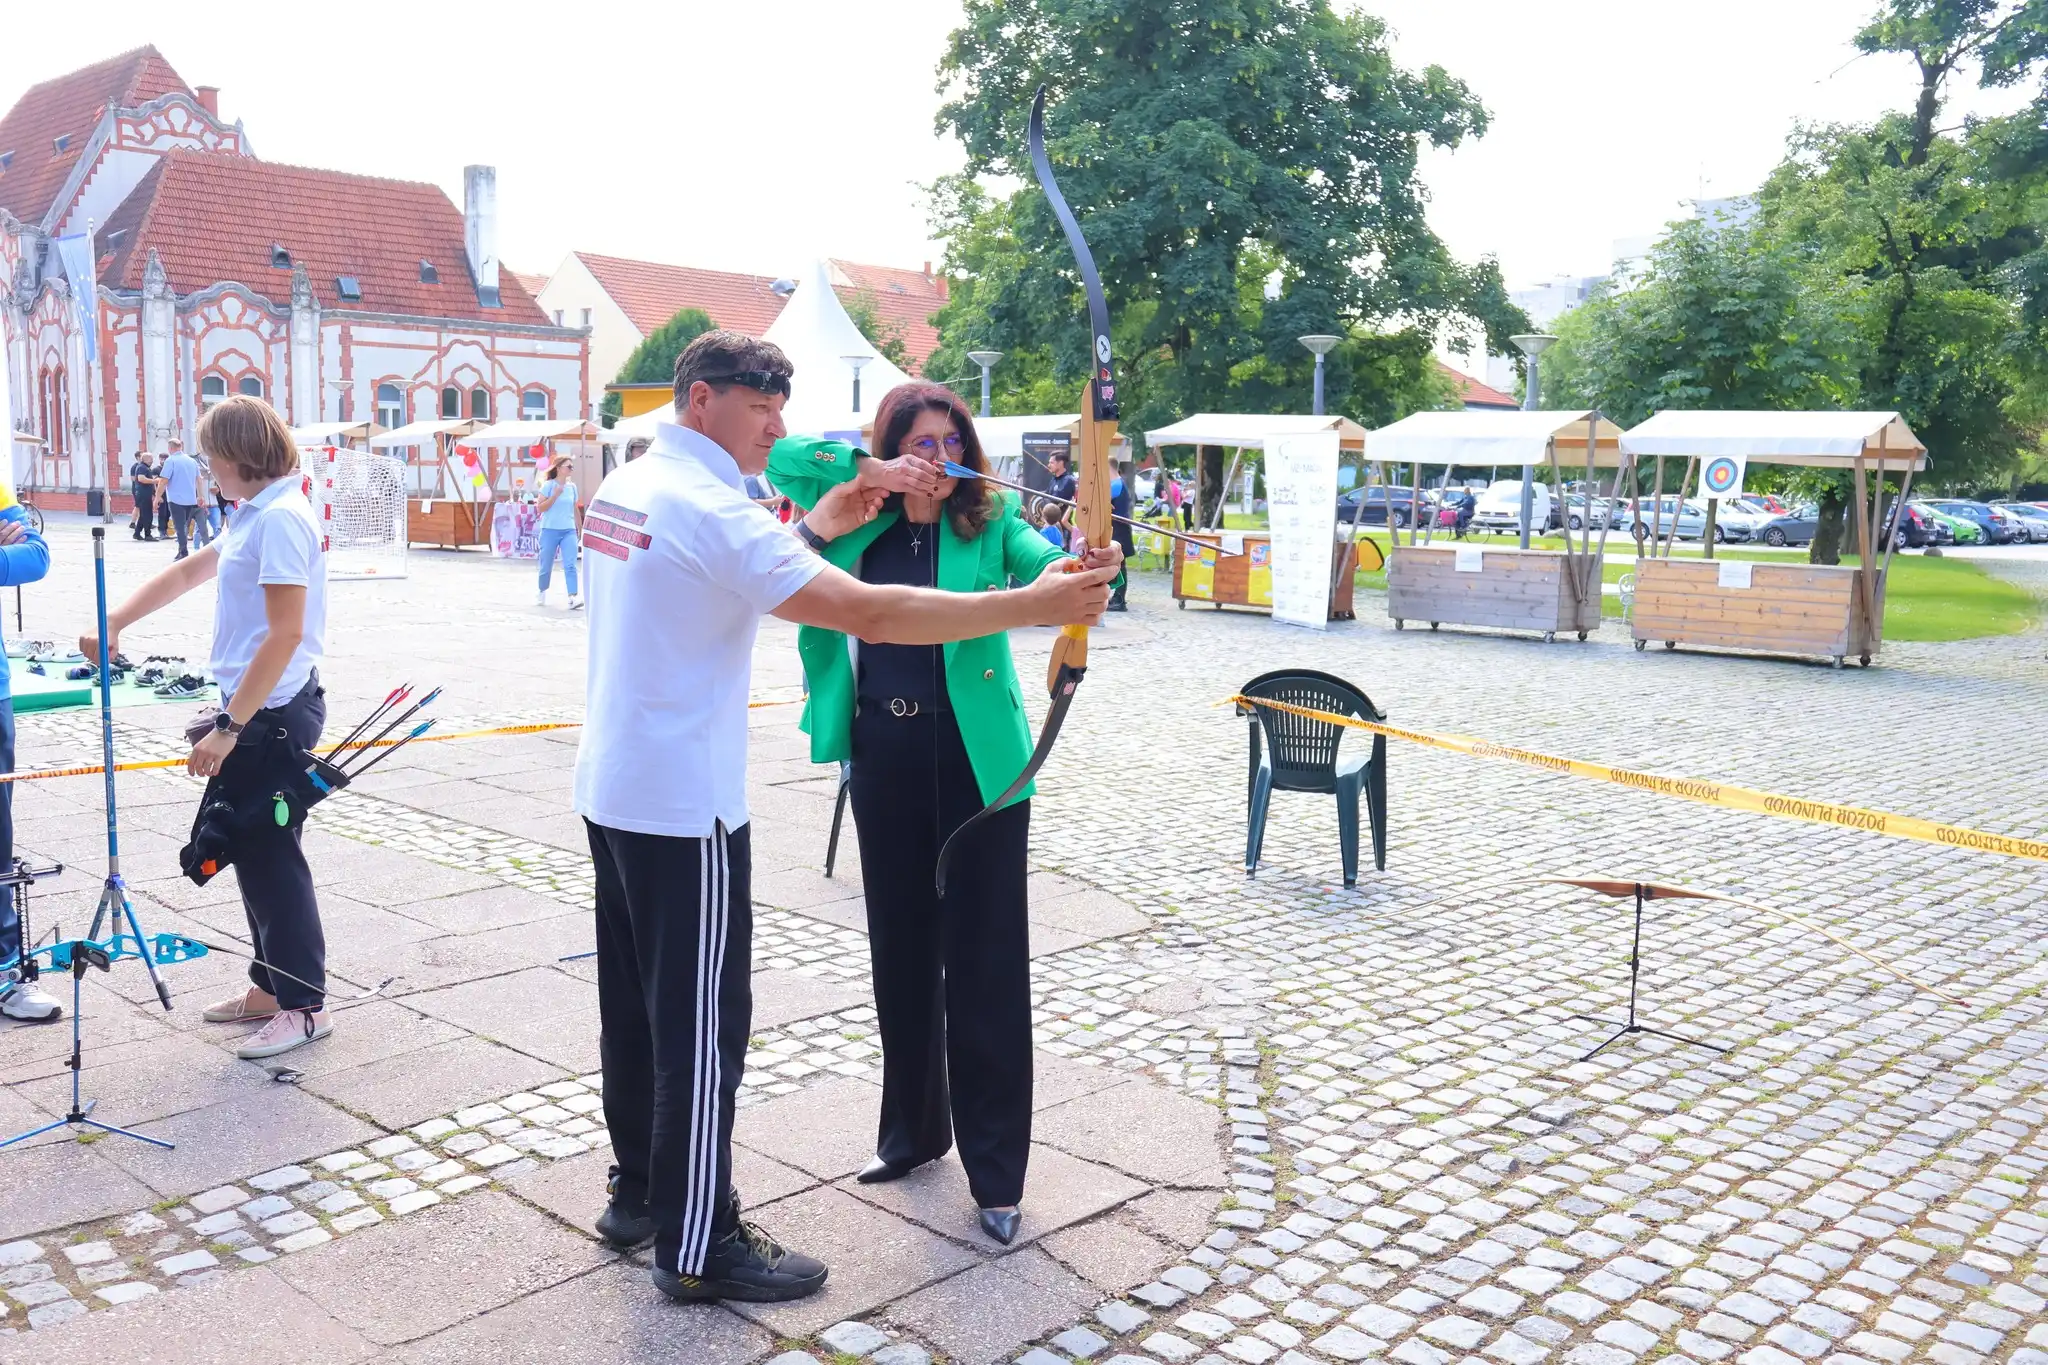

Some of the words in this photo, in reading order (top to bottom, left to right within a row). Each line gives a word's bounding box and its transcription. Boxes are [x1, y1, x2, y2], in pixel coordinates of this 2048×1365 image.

[520, 536, 540, 550] ZRIN
[1530, 753, 1571, 772] POZOR
[1610, 768, 1672, 792] PLINOVOD
[1676, 780, 1720, 801] POZOR
[1763, 796, 1832, 822] PLINOVOD
[1836, 808, 1886, 831] POZOR
[1936, 827, 2013, 853] PLINOVOD
[2018, 842, 2048, 859] ZOR
